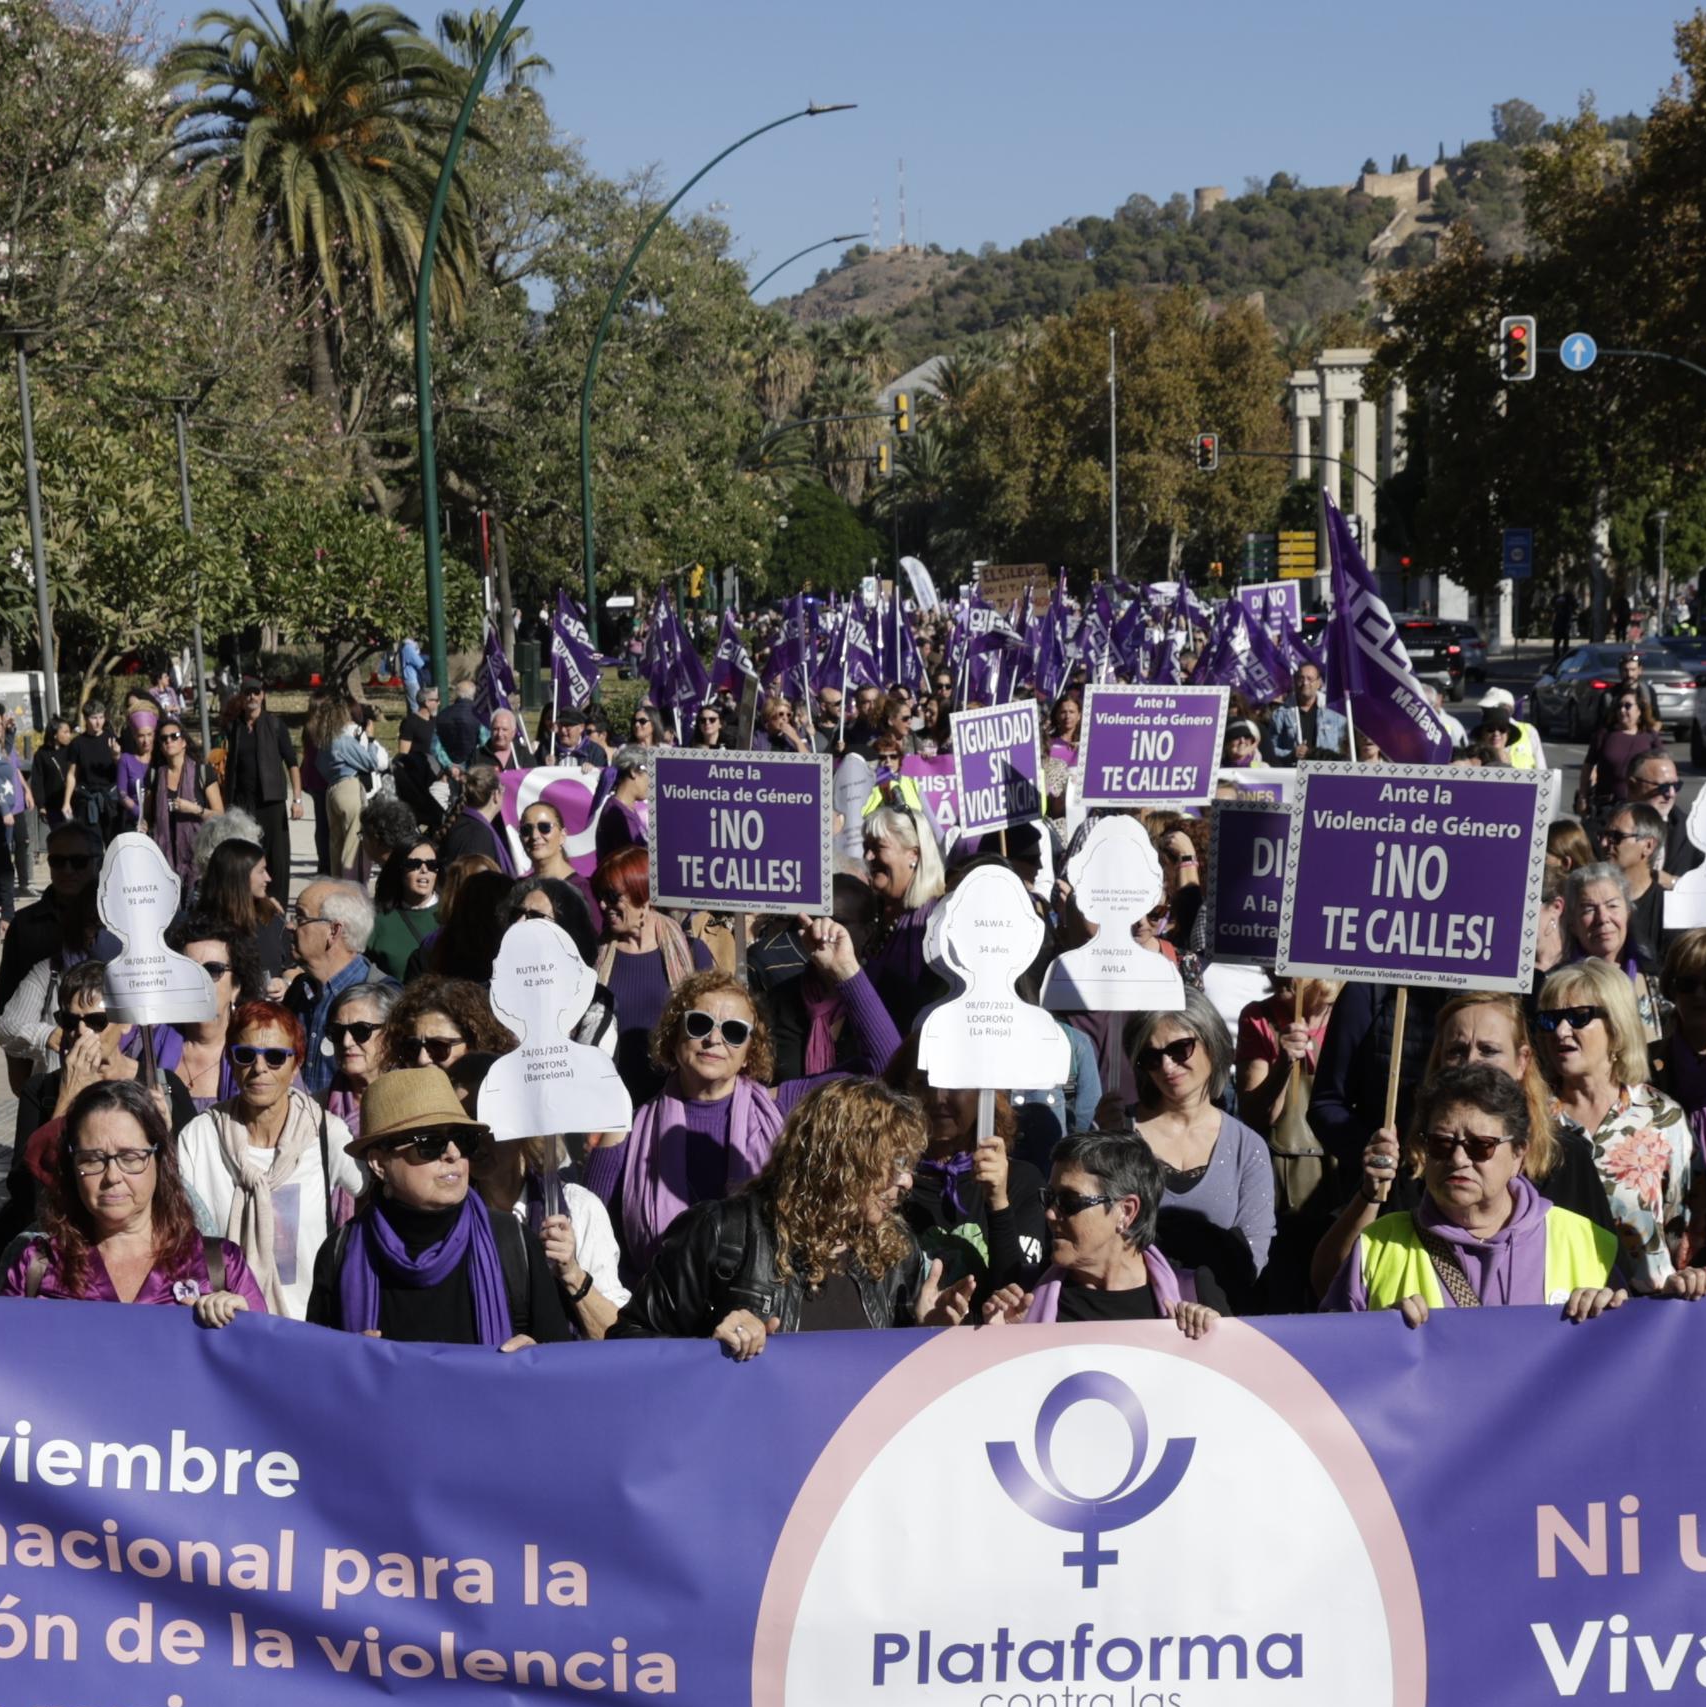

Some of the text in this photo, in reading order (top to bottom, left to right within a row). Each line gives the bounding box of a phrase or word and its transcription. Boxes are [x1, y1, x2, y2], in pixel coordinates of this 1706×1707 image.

[1251, 595, 1263, 609] DI
[1134, 696, 1177, 708] Ante la
[1096, 713, 1213, 726] Violencia de Género
[1391, 685, 1443, 746] Málaga
[959, 712, 1033, 756] IGUALDAD
[1130, 730, 1175, 762] ¡NO
[708, 764, 761, 781] Ante la
[989, 750, 1012, 785] SIN
[1102, 766, 1198, 792] TE CALLES!
[662, 784, 813, 805] Violencia de Género
[965, 778, 1037, 824] VIOLENCIA
[1379, 783, 1453, 804] Ante la
[710, 807, 764, 851] ¡NO
[1313, 809, 1522, 839] Violencia de Género
[1252, 836, 1284, 879] DI
[678, 855, 802, 893] TE CALLES!
[1371, 841, 1449, 901] ¡NO
[122, 884, 159, 894] EVARISTA
[128, 896, 156, 905] 91 años
[1243, 895, 1278, 913] A la
[974, 919, 1013, 928] SALWA Z.
[1219, 922, 1279, 939] contra
[1322, 906, 1495, 961] TE CALLES!
[979, 945, 1009, 954] 34 años
[516, 963, 557, 975] RUTH R.P.
[1333, 966, 1376, 978] Plataforma
[1377, 968, 1413, 980] Violencia
[1414, 971, 1433, 981] Cero
[1438, 973, 1468, 985] Málaga
[128, 977, 167, 990] (Tenerife)
[523, 977, 554, 988] 42 años
[965, 1001, 1014, 1010] 08/07/2023
[967, 1012, 1013, 1024] LOGROÑO
[969, 1027, 1012, 1037] (La Rioja)
[521, 1045, 569, 1058] 24/01/2023
[527, 1060, 568, 1071] PONTONS
[524, 1068, 574, 1083] (Barcelona)
[1535, 1494, 1641, 1578] Ni
[322, 1546, 494, 1610] para
[524, 1544, 588, 1607] la
[106, 1602, 205, 1666] de
[232, 1612, 294, 1668] la
[316, 1626, 677, 1695] violencia
[872, 1623, 1305, 1686] Plataforma
